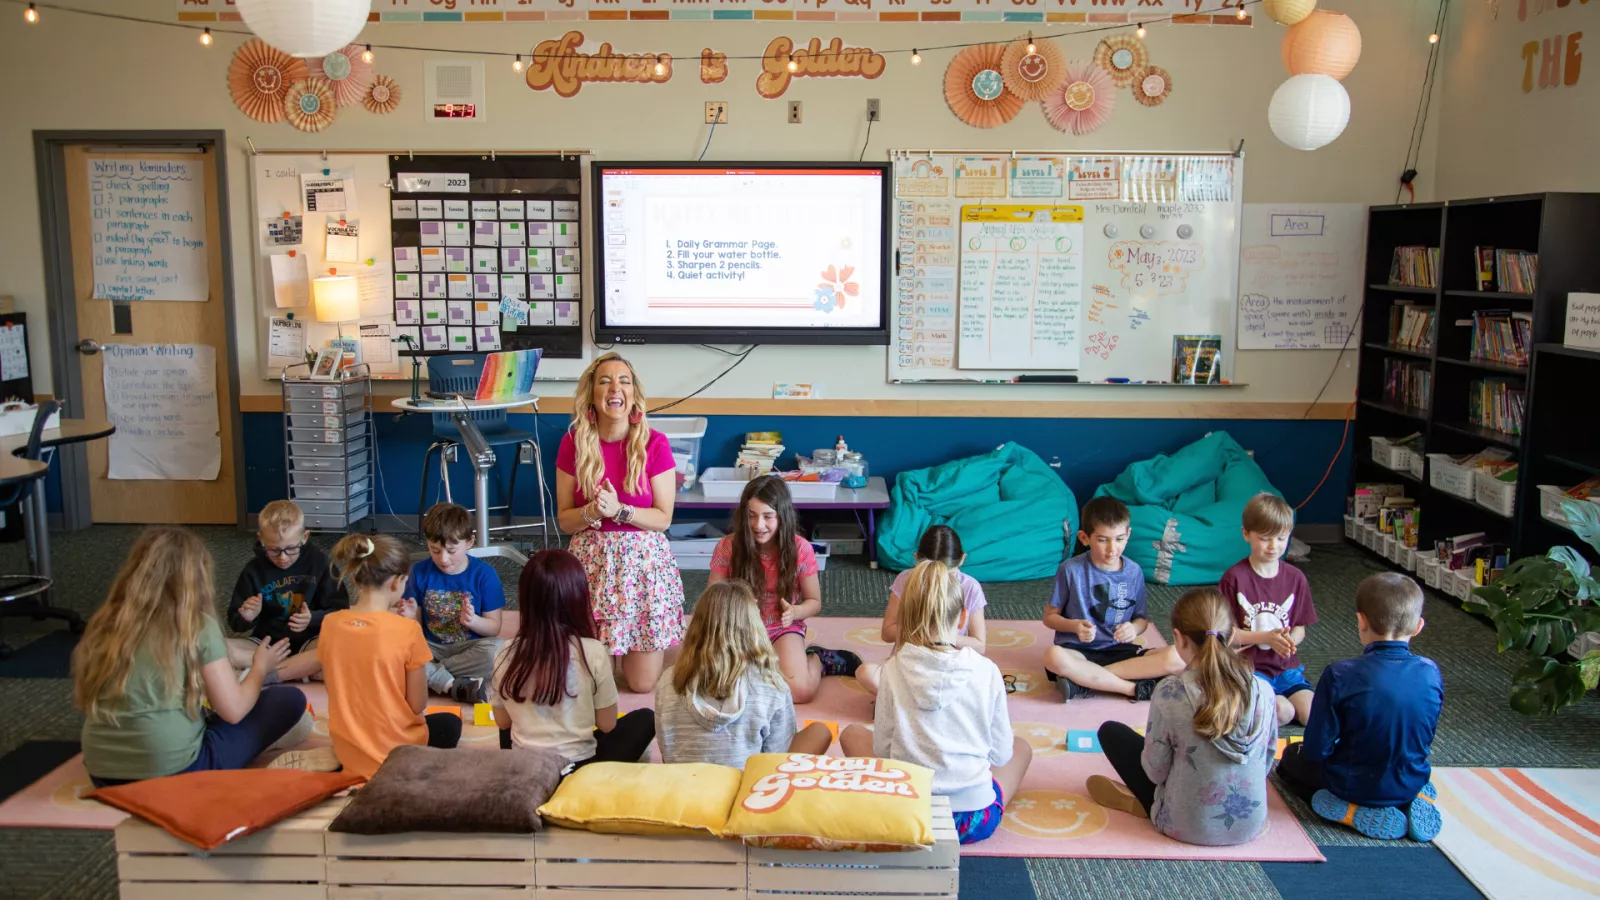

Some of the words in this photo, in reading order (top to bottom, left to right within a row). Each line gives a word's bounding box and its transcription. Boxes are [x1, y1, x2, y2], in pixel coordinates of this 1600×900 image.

[526, 30, 675, 98] Kindness
[700, 47, 728, 83] is
[756, 36, 885, 98] Golden
[1521, 31, 1583, 94] THE
[95, 161, 134, 176] Writing
[139, 161, 187, 175] Reminders
[265, 169, 271, 178] I
[275, 167, 296, 179] could
[1022, 169, 1045, 177] LEVEL
[1078, 171, 1101, 179] LEVEL
[1103, 167, 1111, 179] 2
[106, 181, 132, 191] check
[137, 181, 170, 194] spelling
[417, 178, 431, 188] May
[447, 178, 468, 187] 2023
[108, 193, 114, 204] 3
[119, 196, 169, 208] paragraphs
[448, 206, 465, 214] Tuesday
[1095, 204, 1111, 213] Mrs
[104, 208, 111, 217] 4
[116, 209, 158, 220] sentences
[162, 211, 169, 221] in
[172, 211, 193, 222] each
[107, 220, 150, 232] paragraph
[1283, 217, 1310, 231] Area
[183, 238, 204, 250] begin
[677, 240, 700, 250] Daily
[702, 240, 748, 250] Grammar
[751, 240, 779, 251] Page.
[115, 246, 153, 257] paragraph
[667, 251, 675, 260] 2.
[677, 250, 690, 260] Fill
[693, 252, 714, 262] your
[717, 251, 747, 260] water
[750, 250, 782, 260] bottle.
[104, 257, 117, 265] use
[148, 259, 169, 268] words
[1126, 247, 1156, 270] May
[1168, 248, 1197, 263] 2023
[667, 261, 675, 270] 3.
[677, 261, 717, 272] Sharpen
[719, 261, 726, 270] 2
[727, 261, 763, 272] pencils.
[666, 271, 675, 280] 4.
[677, 271, 704, 281] Quiet
[706, 271, 745, 282] activity!
[1244, 295, 1266, 307] Area
[1273, 297, 1284, 305] the
[1337, 294, 1347, 304] of
[1245, 322, 1266, 333] object
[112, 344, 149, 358] Opinion
[155, 345, 194, 358] Writing
[775, 753, 911, 780] Stay
[741, 770, 920, 814] Golden
